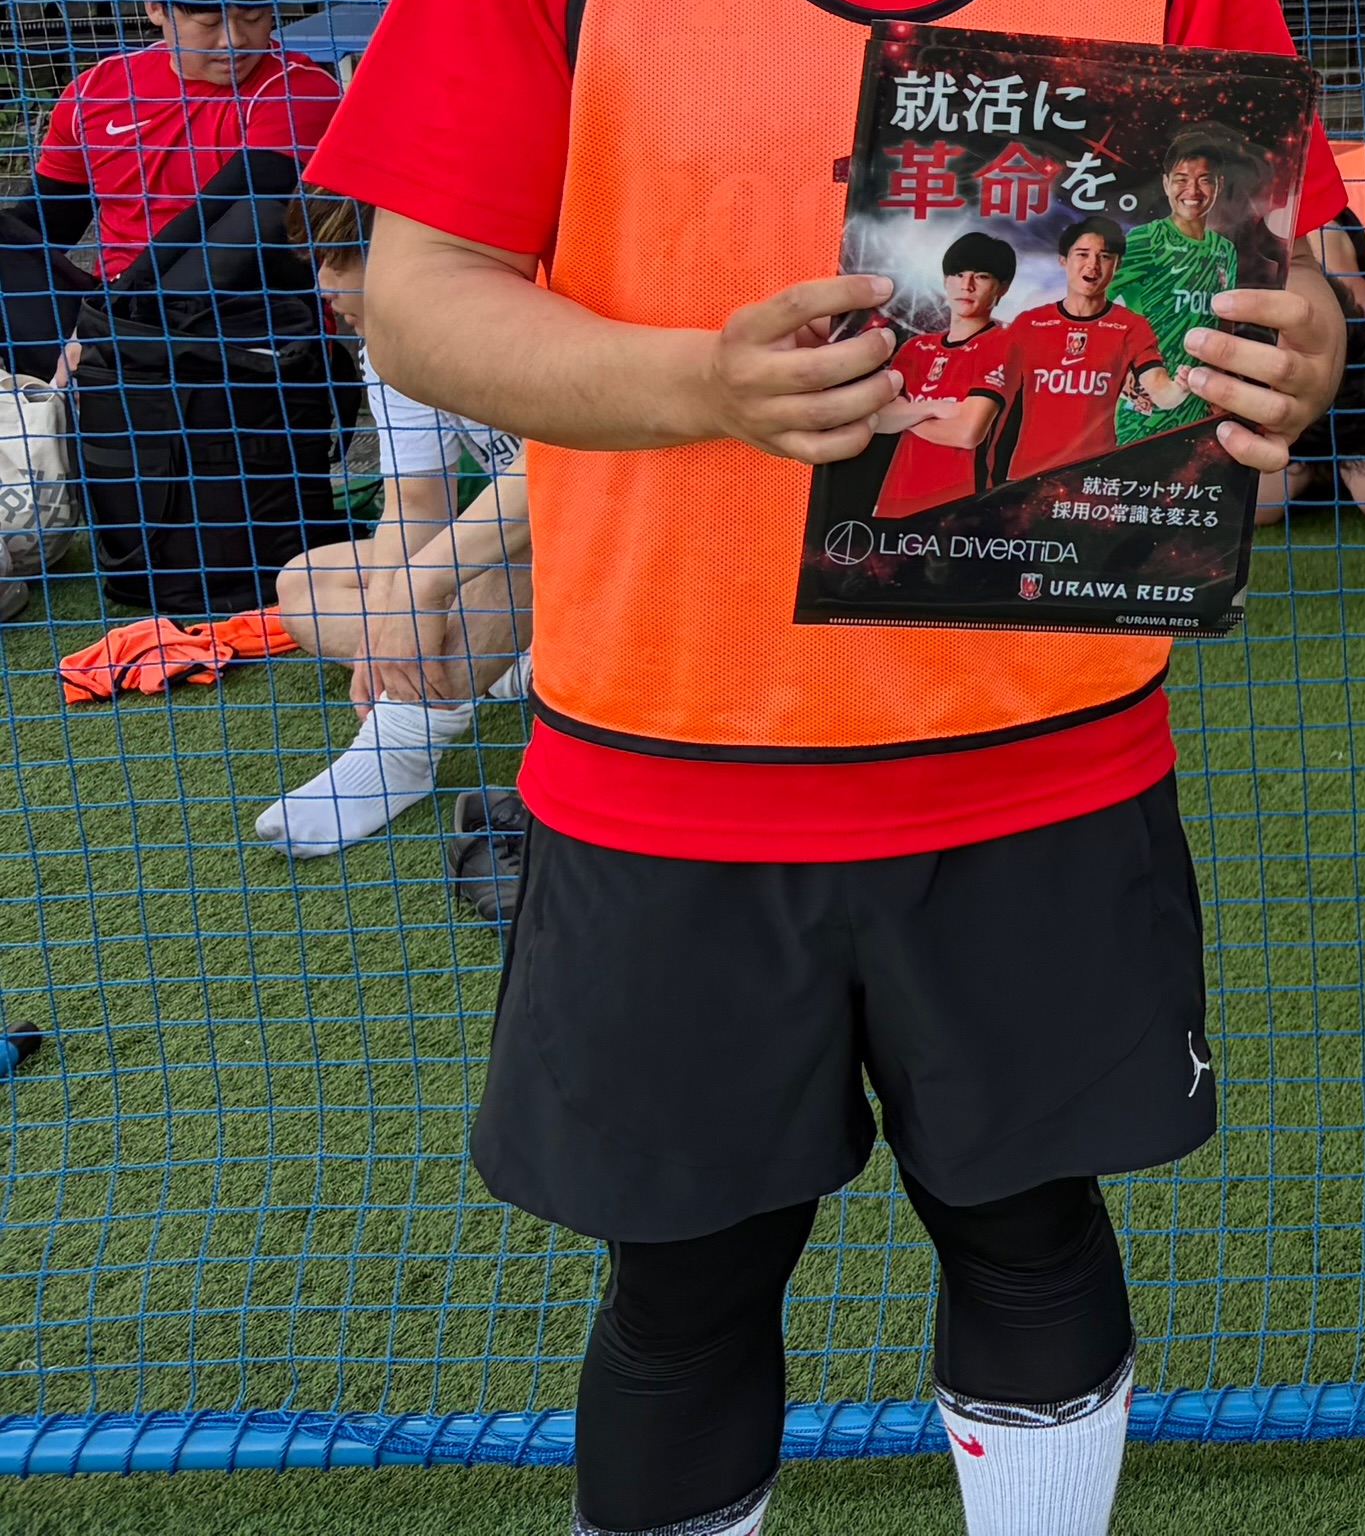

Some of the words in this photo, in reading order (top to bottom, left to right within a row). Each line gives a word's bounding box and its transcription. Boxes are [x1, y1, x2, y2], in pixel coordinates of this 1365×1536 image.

[890, 69, 1088, 134] 就活に
[877, 140, 1138, 222] 革命を。
[1034, 368, 1112, 396] POLUS
[1082, 476, 1222, 501] 就活フットサルで
[1052, 500, 1219, 528] 採用の常識を変える
[1049, 580, 1128, 600] URAWA
[1137, 583, 1196, 603] REDS
[1168, 618, 1199, 628] REDS
